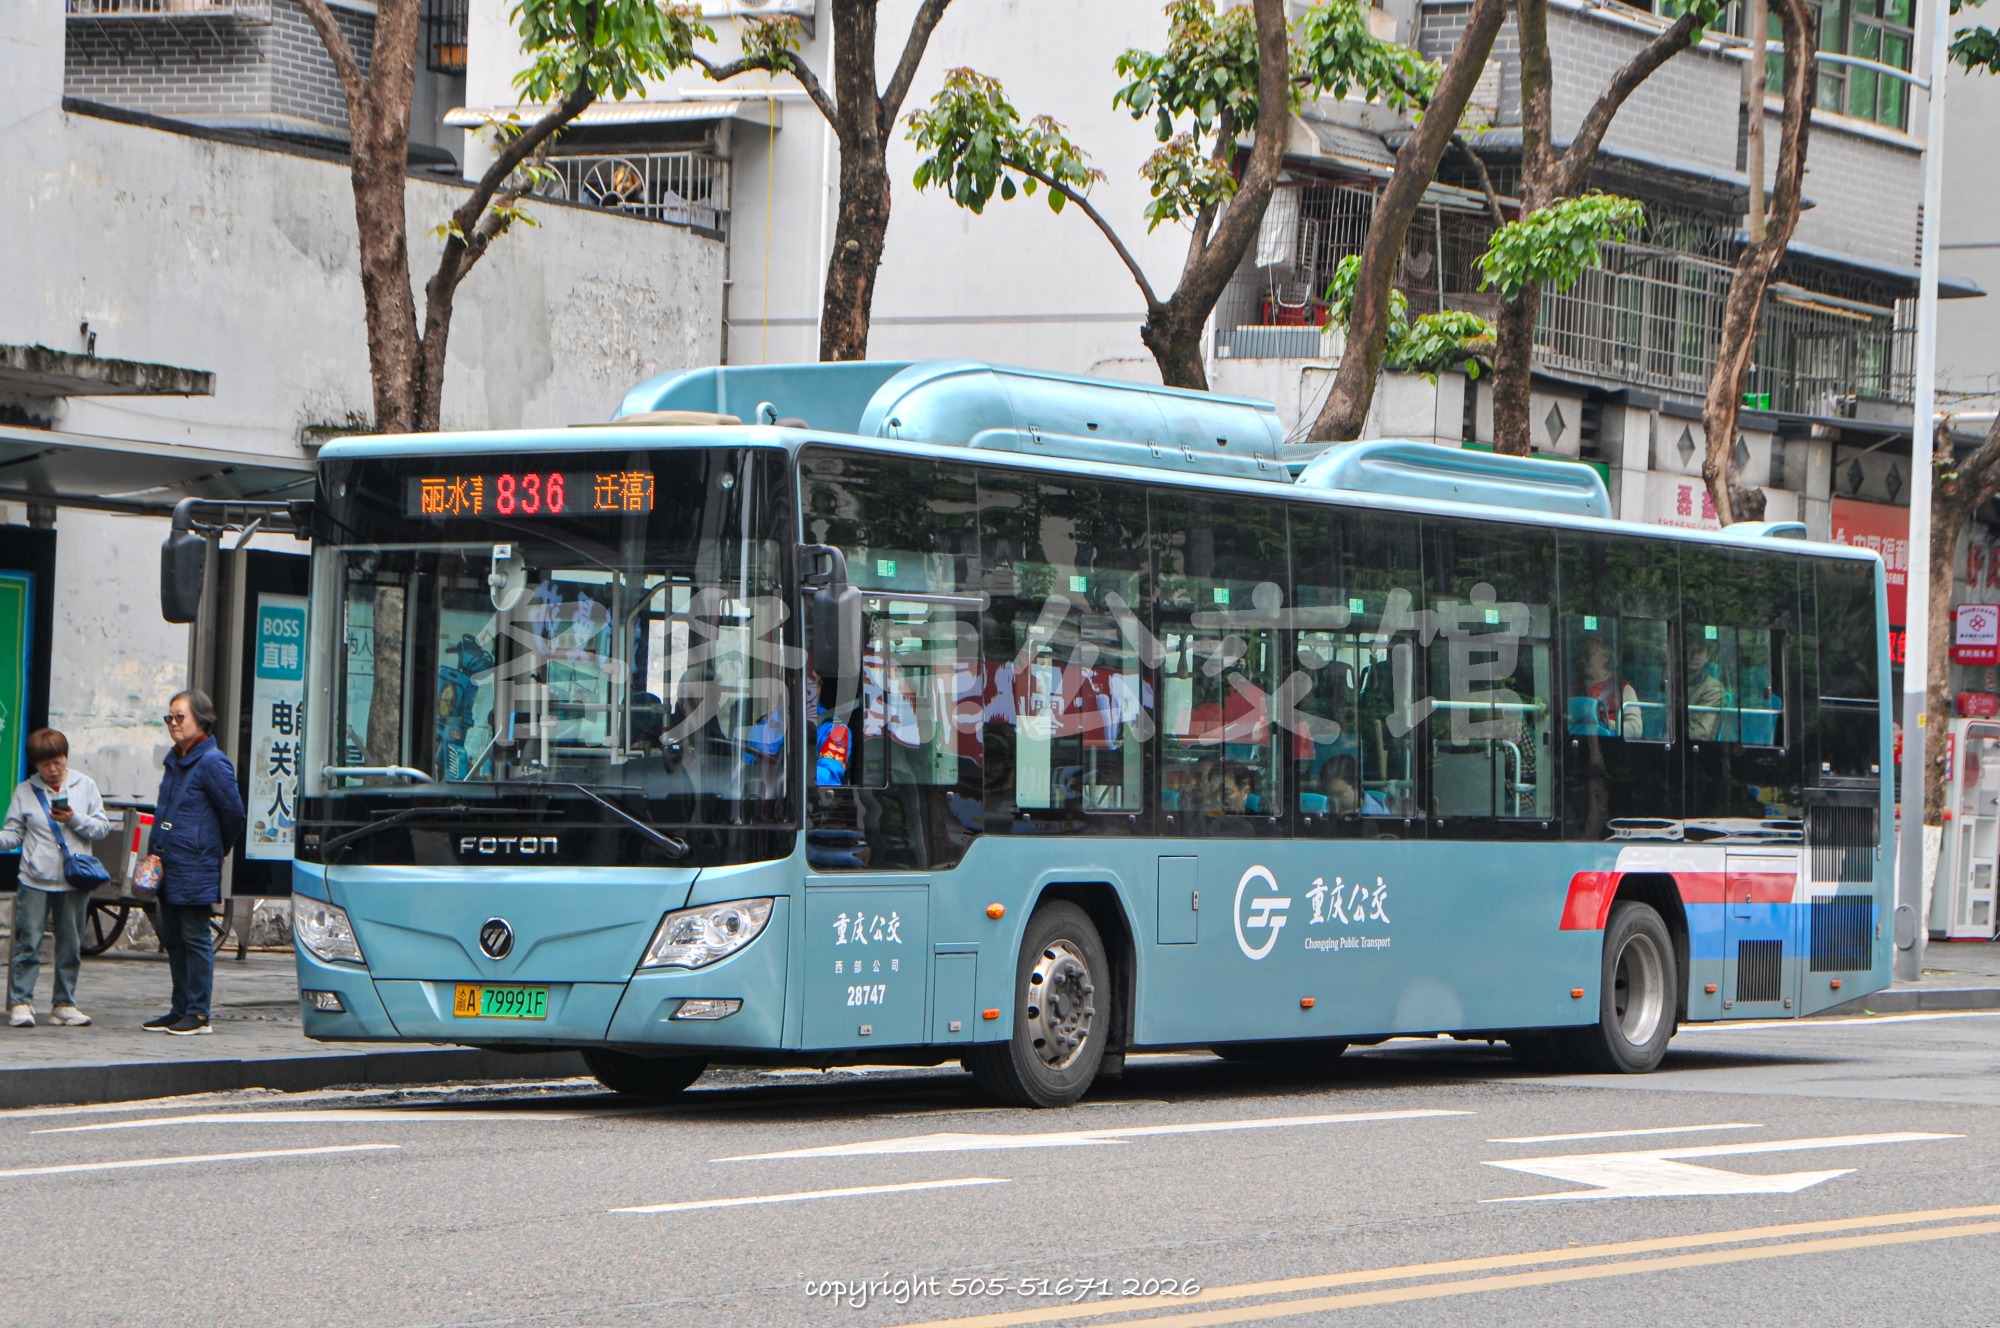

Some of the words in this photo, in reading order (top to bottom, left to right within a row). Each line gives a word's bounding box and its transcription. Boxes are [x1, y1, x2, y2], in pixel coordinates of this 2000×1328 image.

[496, 472, 565, 515] 836
[263, 617, 299, 637] BOSS
[262, 642, 298, 670] 直聘
[460, 837, 558, 854] FOTON
[1305, 876, 1391, 925] 重庆公交
[832, 911, 903, 946] 重庆公交
[1304, 937, 1339, 952] Chongqing
[1340, 936, 1359, 949] Public
[1360, 936, 1391, 950] Transport
[835, 959, 899, 974] 西部公司
[847, 984, 886, 1006] 28747
